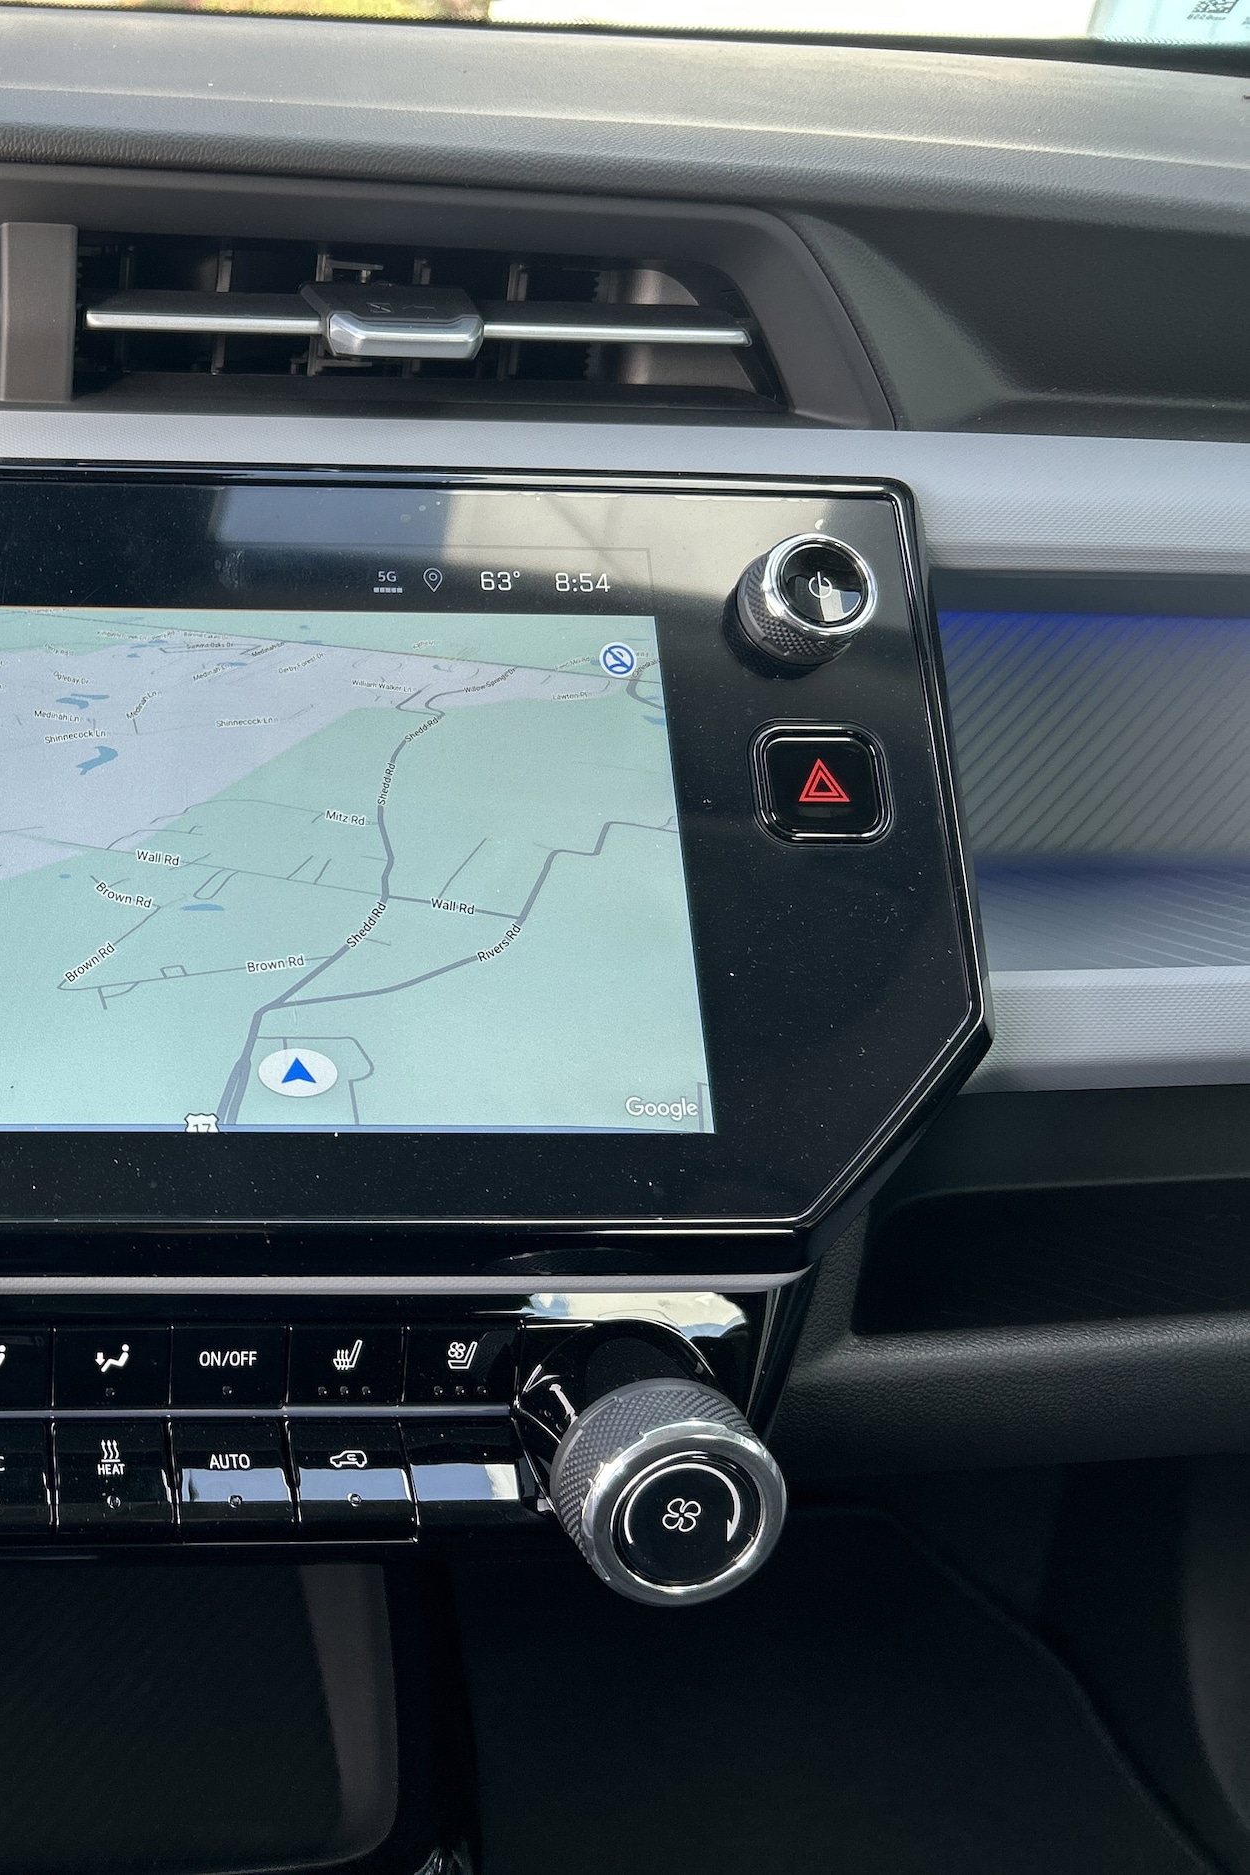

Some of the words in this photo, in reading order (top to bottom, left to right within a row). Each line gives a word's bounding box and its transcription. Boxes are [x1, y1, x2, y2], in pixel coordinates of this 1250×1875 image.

[377, 570, 397, 583] 5G
[479, 570, 521, 593] 63°
[553, 573, 611, 594] 8:54
[351, 679, 378, 689] William
[378, 682, 402, 691] Walker
[126, 698, 149, 720] Medinah
[147, 690, 158, 700] Ln
[553, 693, 578, 701] Lawton
[34, 710, 68, 722] Medinah
[69, 714, 80, 723] Ln
[216, 718, 263, 727] Shinnecock
[263, 716, 274, 724] Ln
[45, 731, 94, 744] Shinnecock
[95, 728, 106, 738] Ln
[404, 724, 428, 743] Shedd
[427, 717, 439, 728] Rd
[378, 775, 392, 806] Shedd
[385, 763, 396, 776] Rd
[325, 810, 349, 823] Mitz
[350, 814, 366, 826] Rd
[137, 850, 162, 864] Wall
[163, 855, 180, 867] Rd
[96, 881, 133, 905] Brown
[135, 895, 152, 908] Rd
[432, 898, 457, 912] Wall
[458, 903, 475, 915] Rd
[346, 915, 377, 948] Shedd
[372, 901, 388, 919] Rd
[477, 937, 512, 963] Rivers
[506, 923, 522, 942] Rd
[65, 955, 101, 983] Brown
[98, 943, 116, 960] Rd
[247, 960, 285, 973] Brown
[287, 955, 305, 968] Rd
[625, 1096, 699, 1120] Google
[199, 1351, 258, 1367] ON/OFF
[97, 1463, 125, 1476] HEAT
[209, 1454, 251, 1471] AUTO
